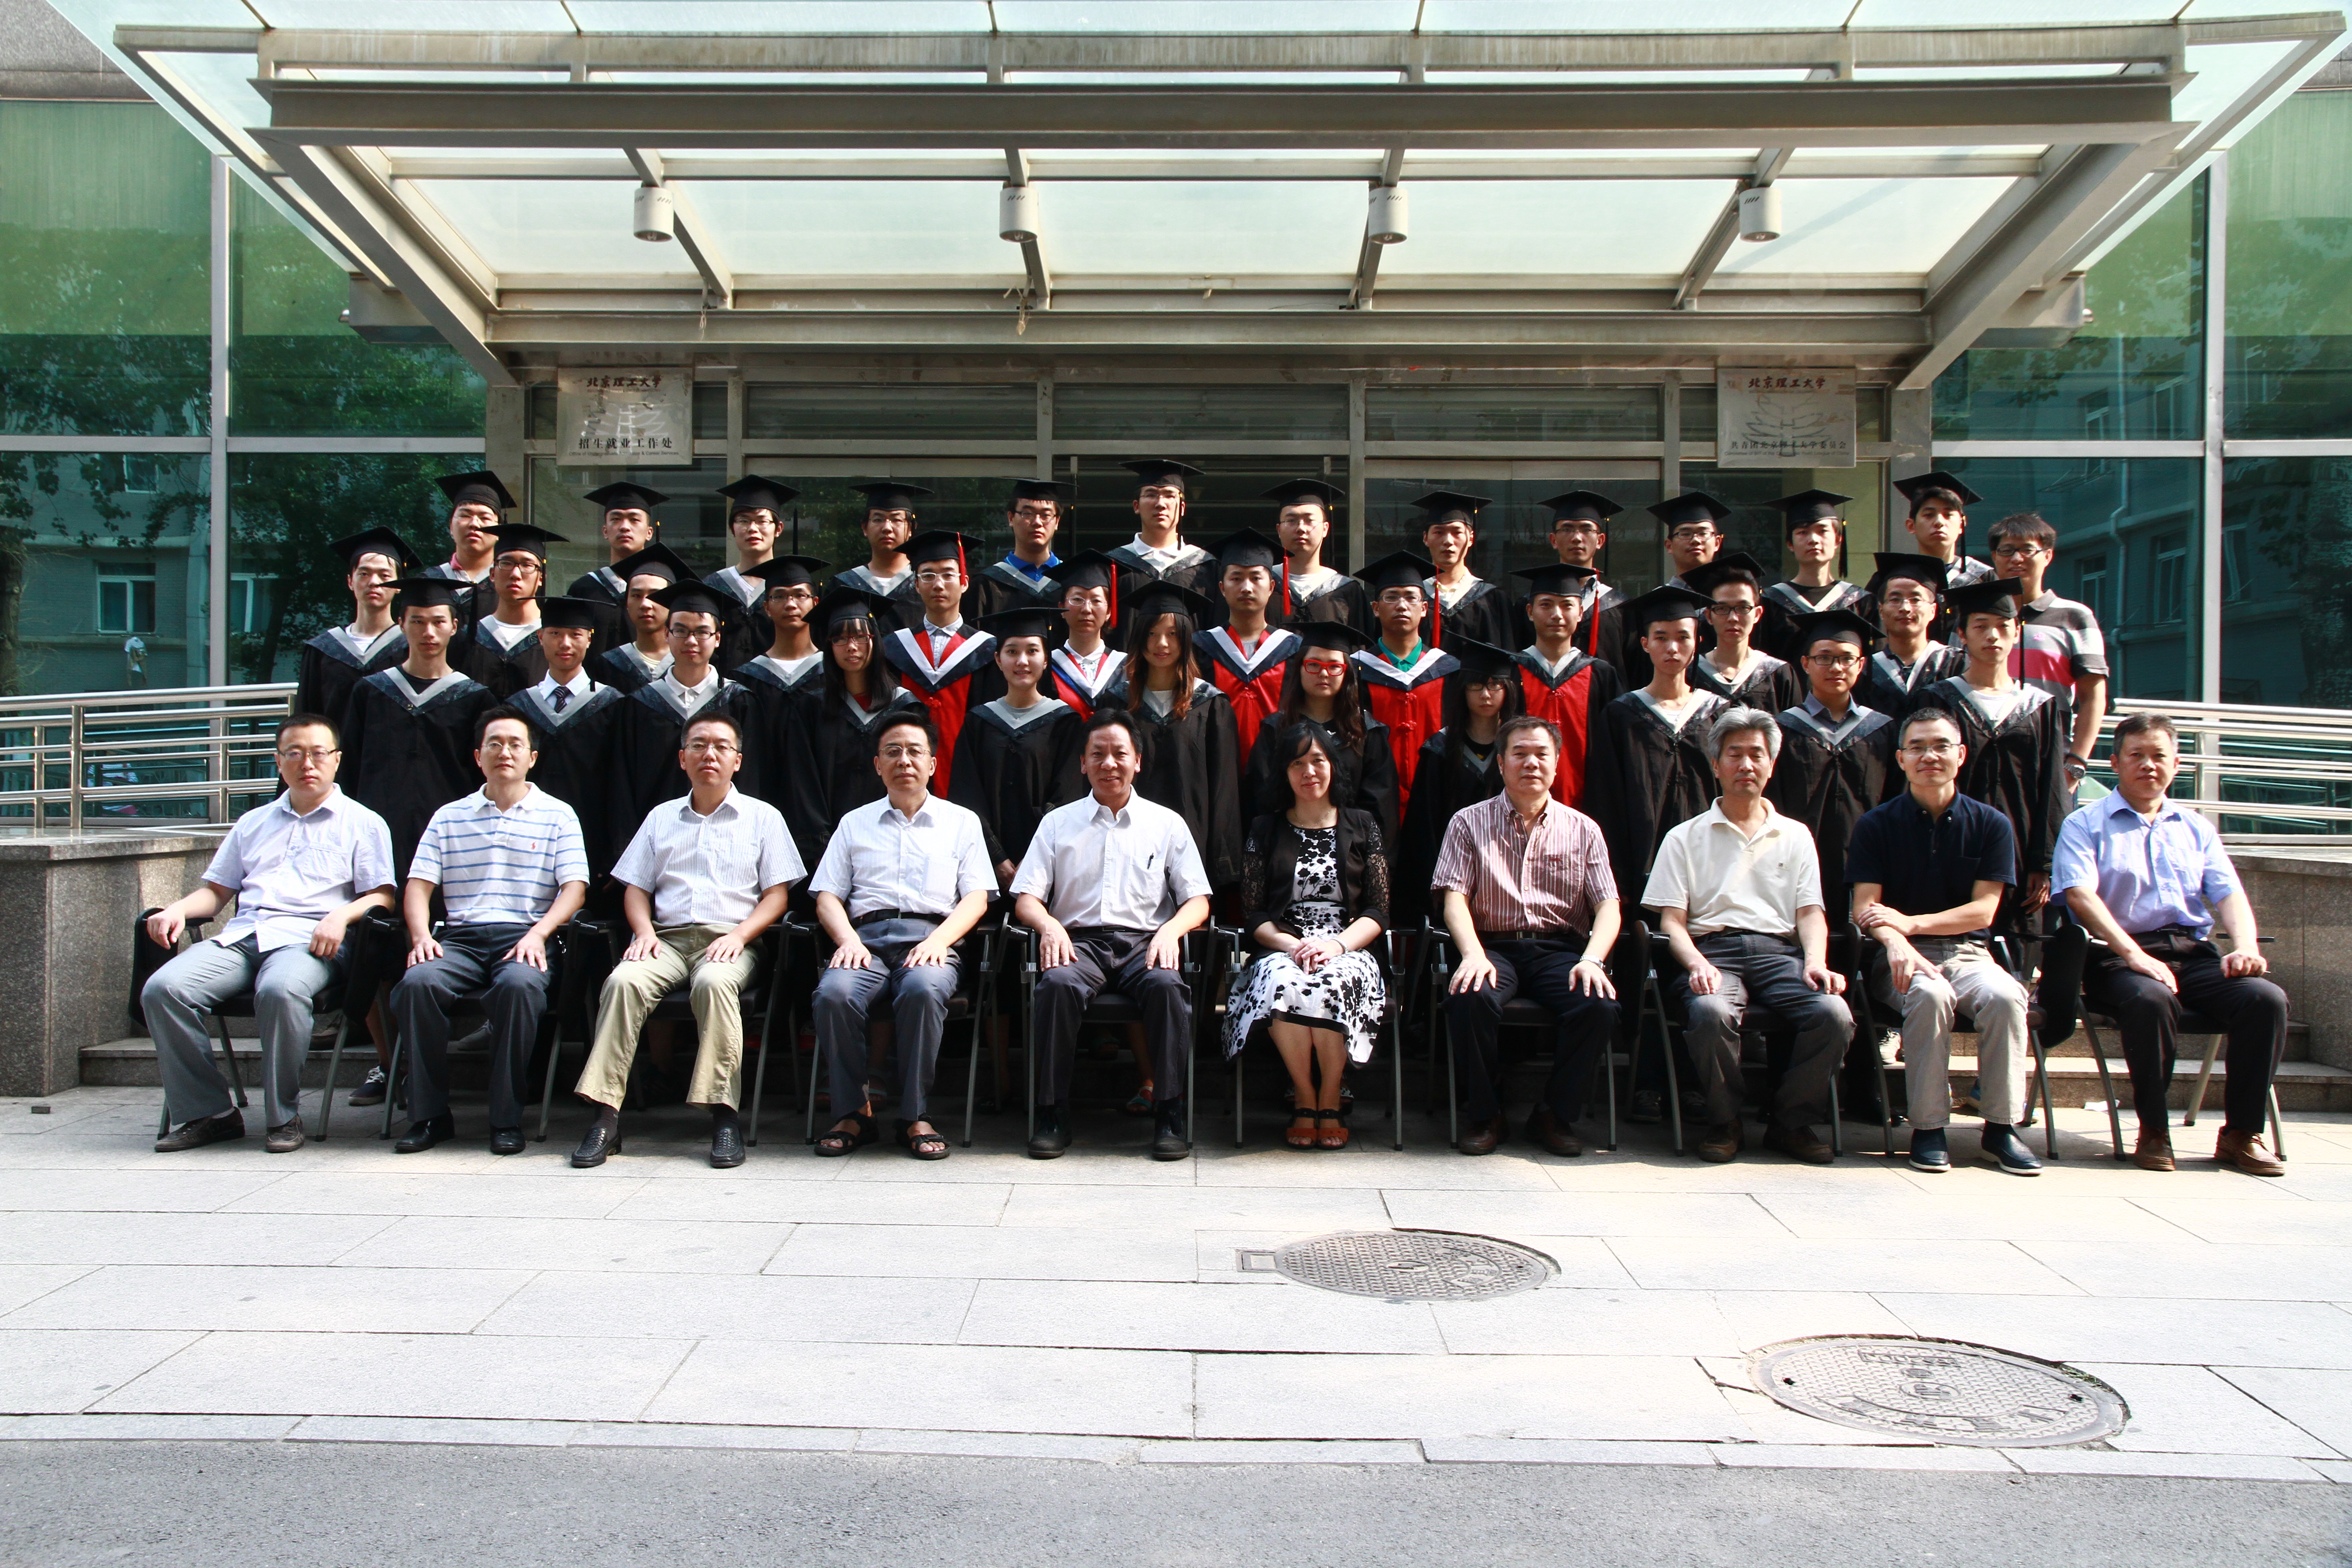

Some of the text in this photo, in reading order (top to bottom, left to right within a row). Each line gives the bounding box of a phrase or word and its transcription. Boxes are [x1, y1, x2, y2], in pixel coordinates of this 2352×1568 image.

[587, 375, 662, 388] 北京理工大学
[1748, 375, 1826, 389] 北京理工大学
[579, 438, 672, 449] 招生就业工作处
